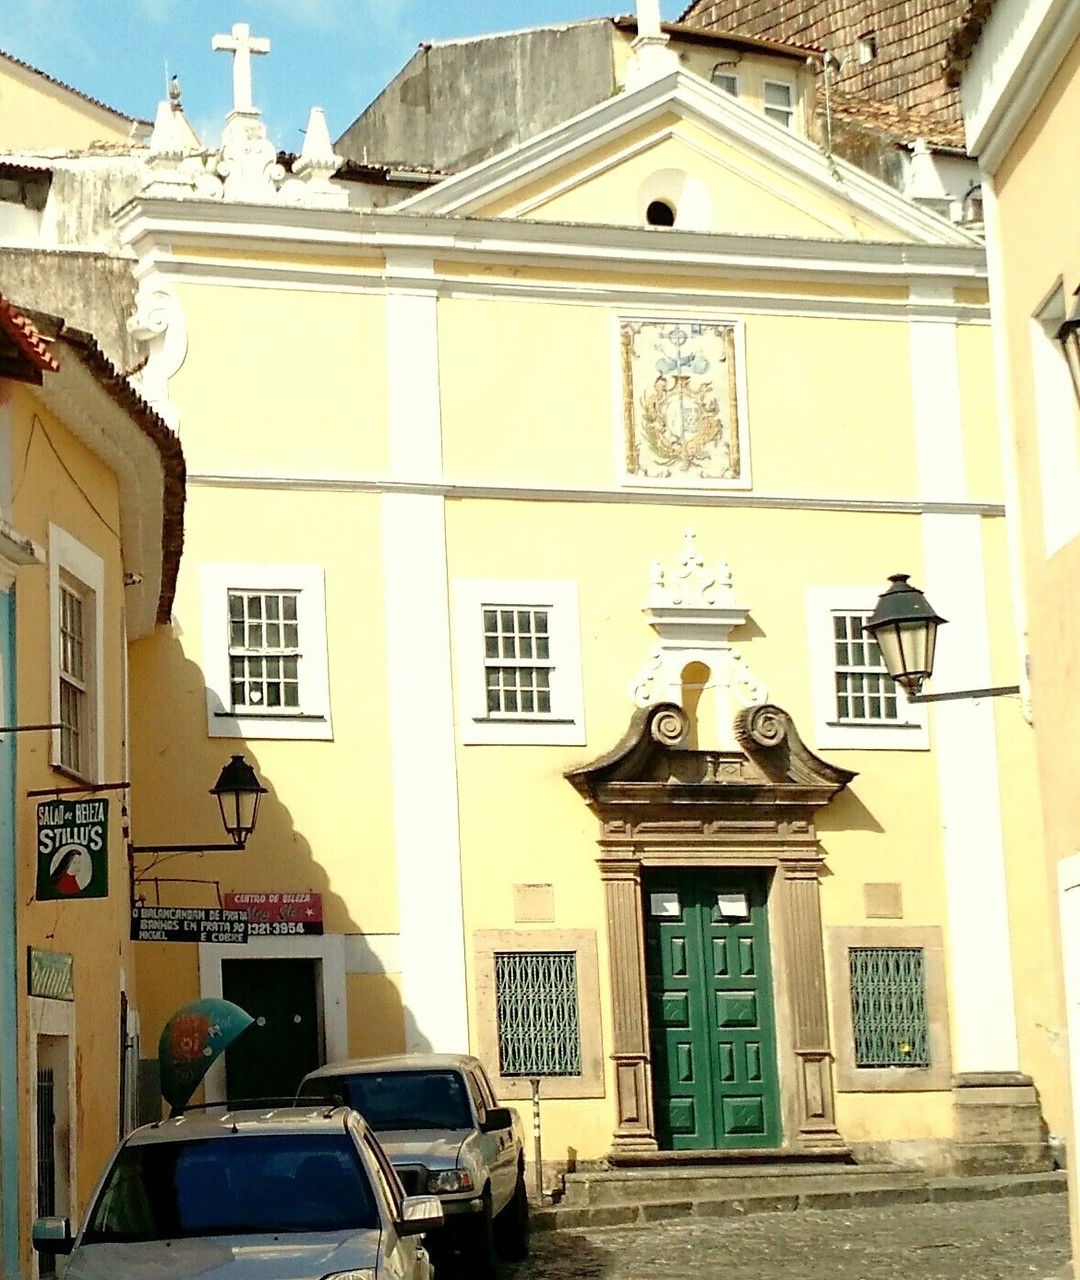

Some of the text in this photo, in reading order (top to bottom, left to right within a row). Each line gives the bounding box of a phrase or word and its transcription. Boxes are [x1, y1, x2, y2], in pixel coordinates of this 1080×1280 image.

[76, 802, 104, 823] BELEZA
[39, 824, 103, 854] STILLU'S
[234, 894, 266, 903] CENTRO
[209, 910, 221, 920] DE
